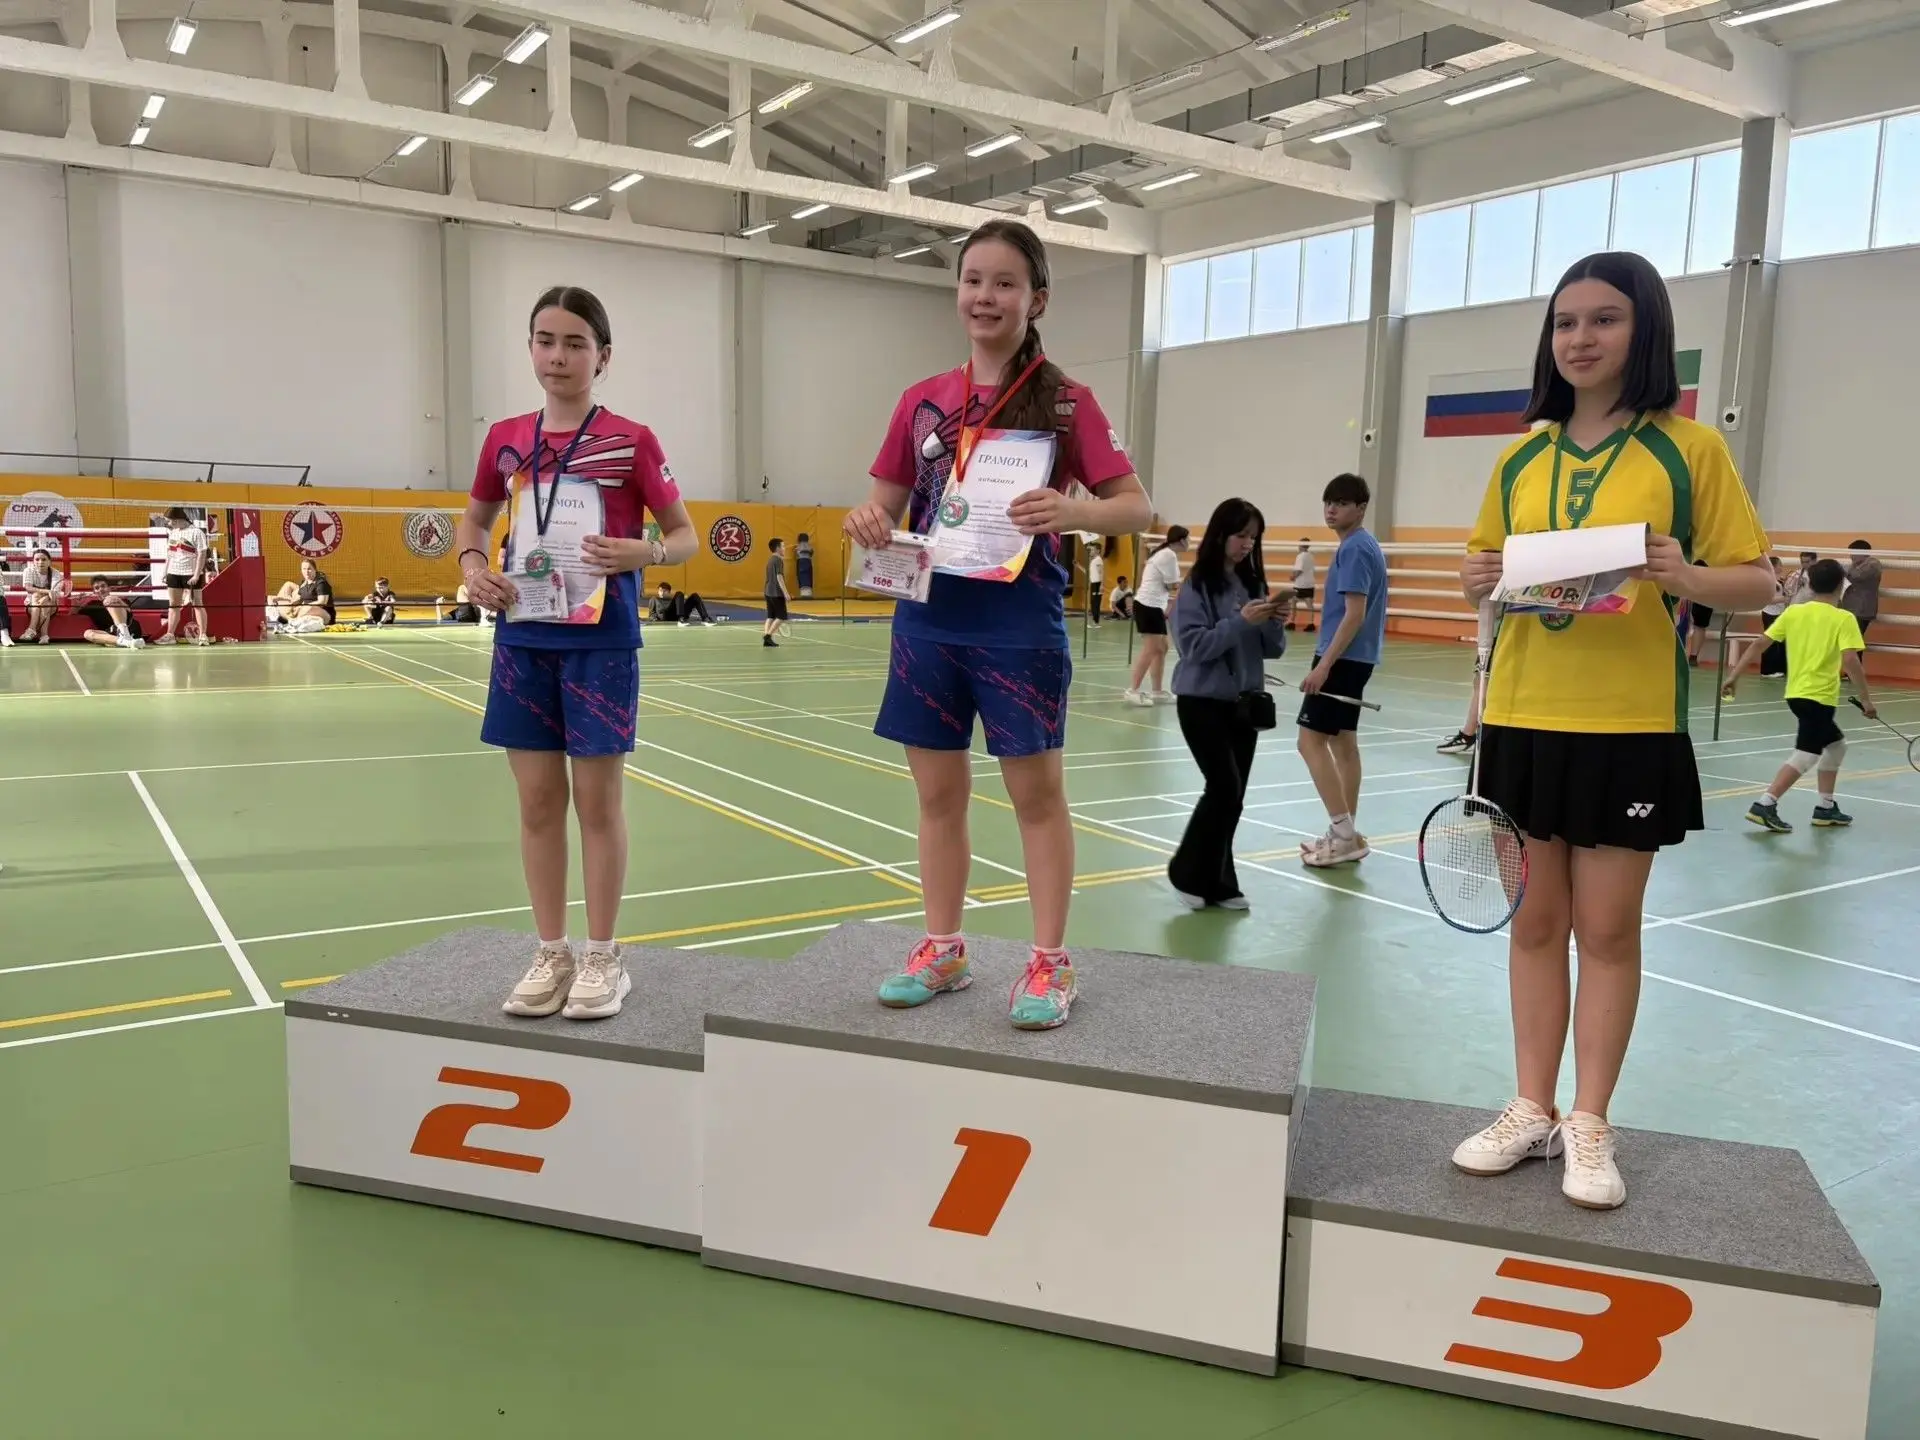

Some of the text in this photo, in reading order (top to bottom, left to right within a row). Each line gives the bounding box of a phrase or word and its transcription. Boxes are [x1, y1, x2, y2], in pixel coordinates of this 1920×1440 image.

[978, 454, 1028, 468] ГРАМОТА
[12, 504, 49, 513] СПОРТ
[1565, 467, 1597, 521] 5
[873, 576, 892, 587] 1500
[413, 1068, 571, 1172] 2
[931, 1129, 1031, 1236] 1
[1446, 1258, 1693, 1389] 3
